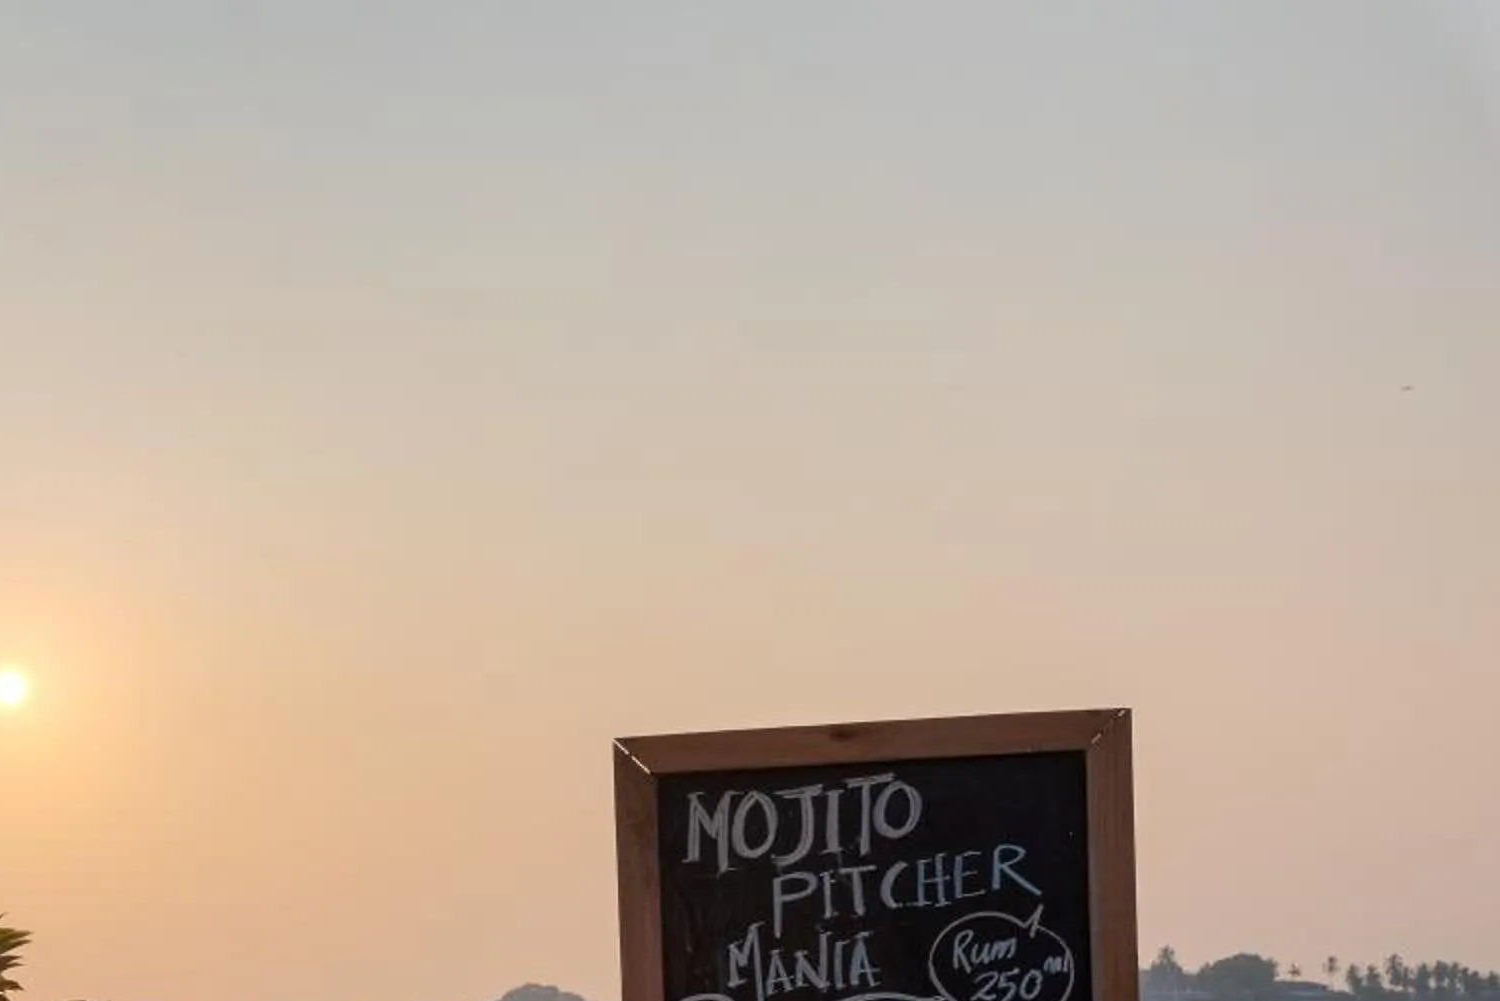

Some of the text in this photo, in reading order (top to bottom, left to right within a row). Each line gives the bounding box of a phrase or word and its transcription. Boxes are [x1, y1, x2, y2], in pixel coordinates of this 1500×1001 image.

[682, 772, 923, 875] MOJITO
[773, 844, 1042, 938] PITCHER
[953, 929, 1017, 974] Rum
